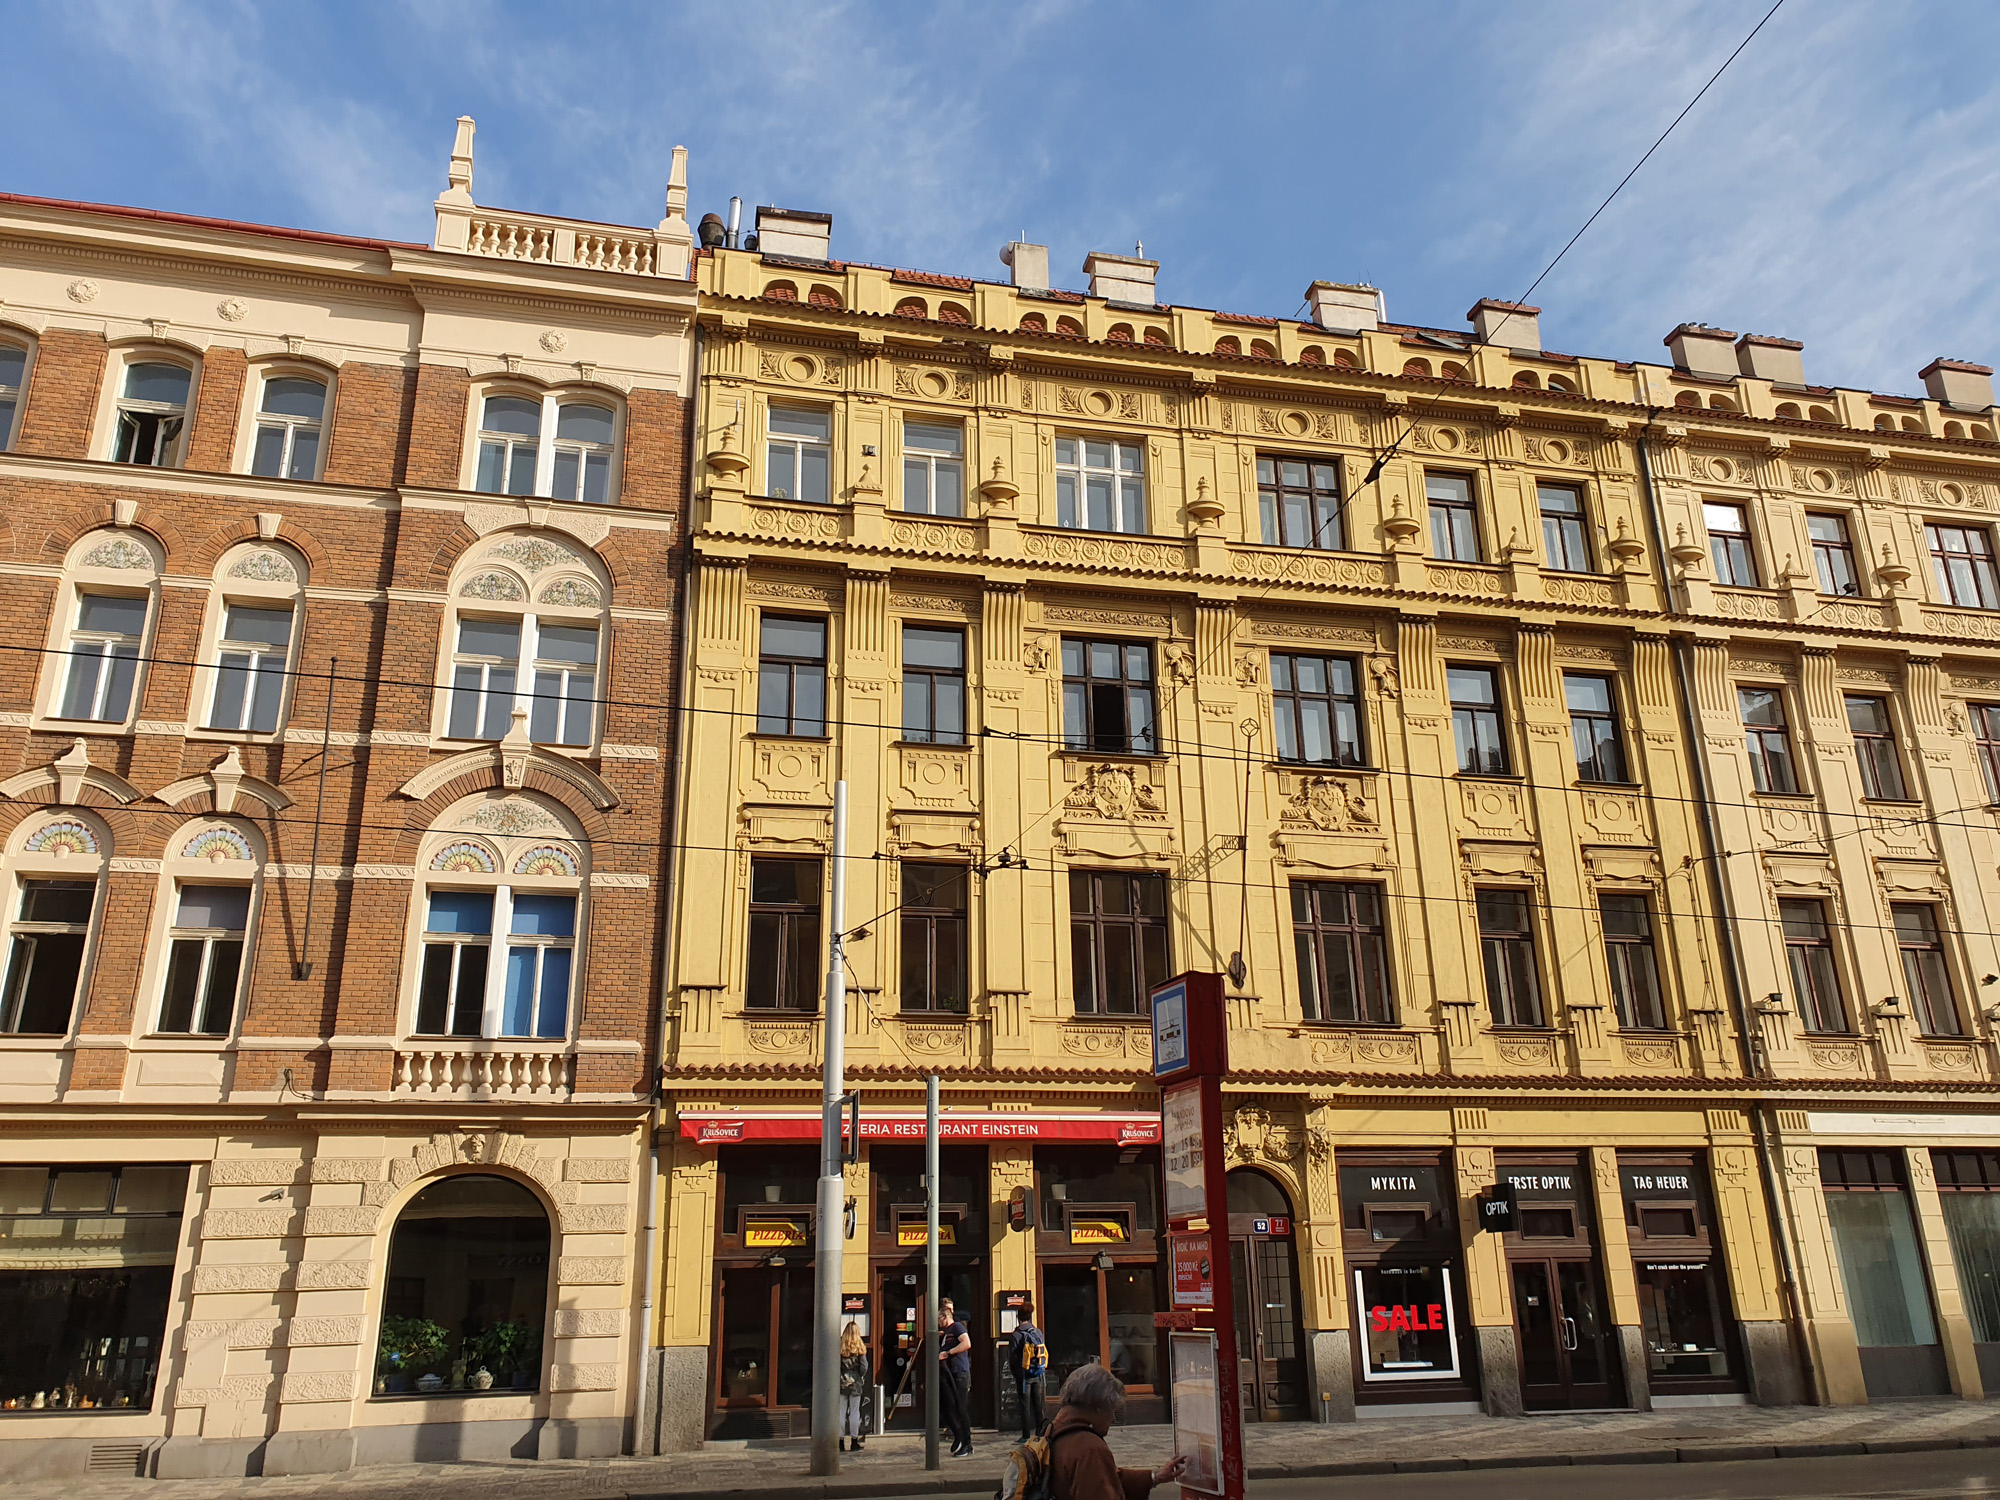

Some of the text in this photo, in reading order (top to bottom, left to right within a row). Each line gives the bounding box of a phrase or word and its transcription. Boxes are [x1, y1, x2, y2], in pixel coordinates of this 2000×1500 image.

[702, 1127, 739, 1137] KRUŠOVICE
[982, 1125, 1038, 1135] EINSTEIN
[1122, 1129, 1154, 1139] KRUŠOVICE
[1181, 1138, 1189, 1151] 15
[1170, 1158, 1178, 1171] 12
[1181, 1155, 1189, 1168] 20
[1371, 1177, 1416, 1190] MYKITA
[1541, 1176, 1571, 1189] OPTIK
[1632, 1176, 1688, 1189] TAG HEUER
[1485, 1201, 1508, 1216] OPTIK
[1257, 1222, 1266, 1230] 52
[1275, 1219, 1283, 1227] 77
[752, 1230, 804, 1240] PIZZERIA
[903, 1231, 951, 1240] PIZZIA
[1074, 1229, 1119, 1238] PIZZERIA
[1371, 1304, 1443, 1332] SALE
